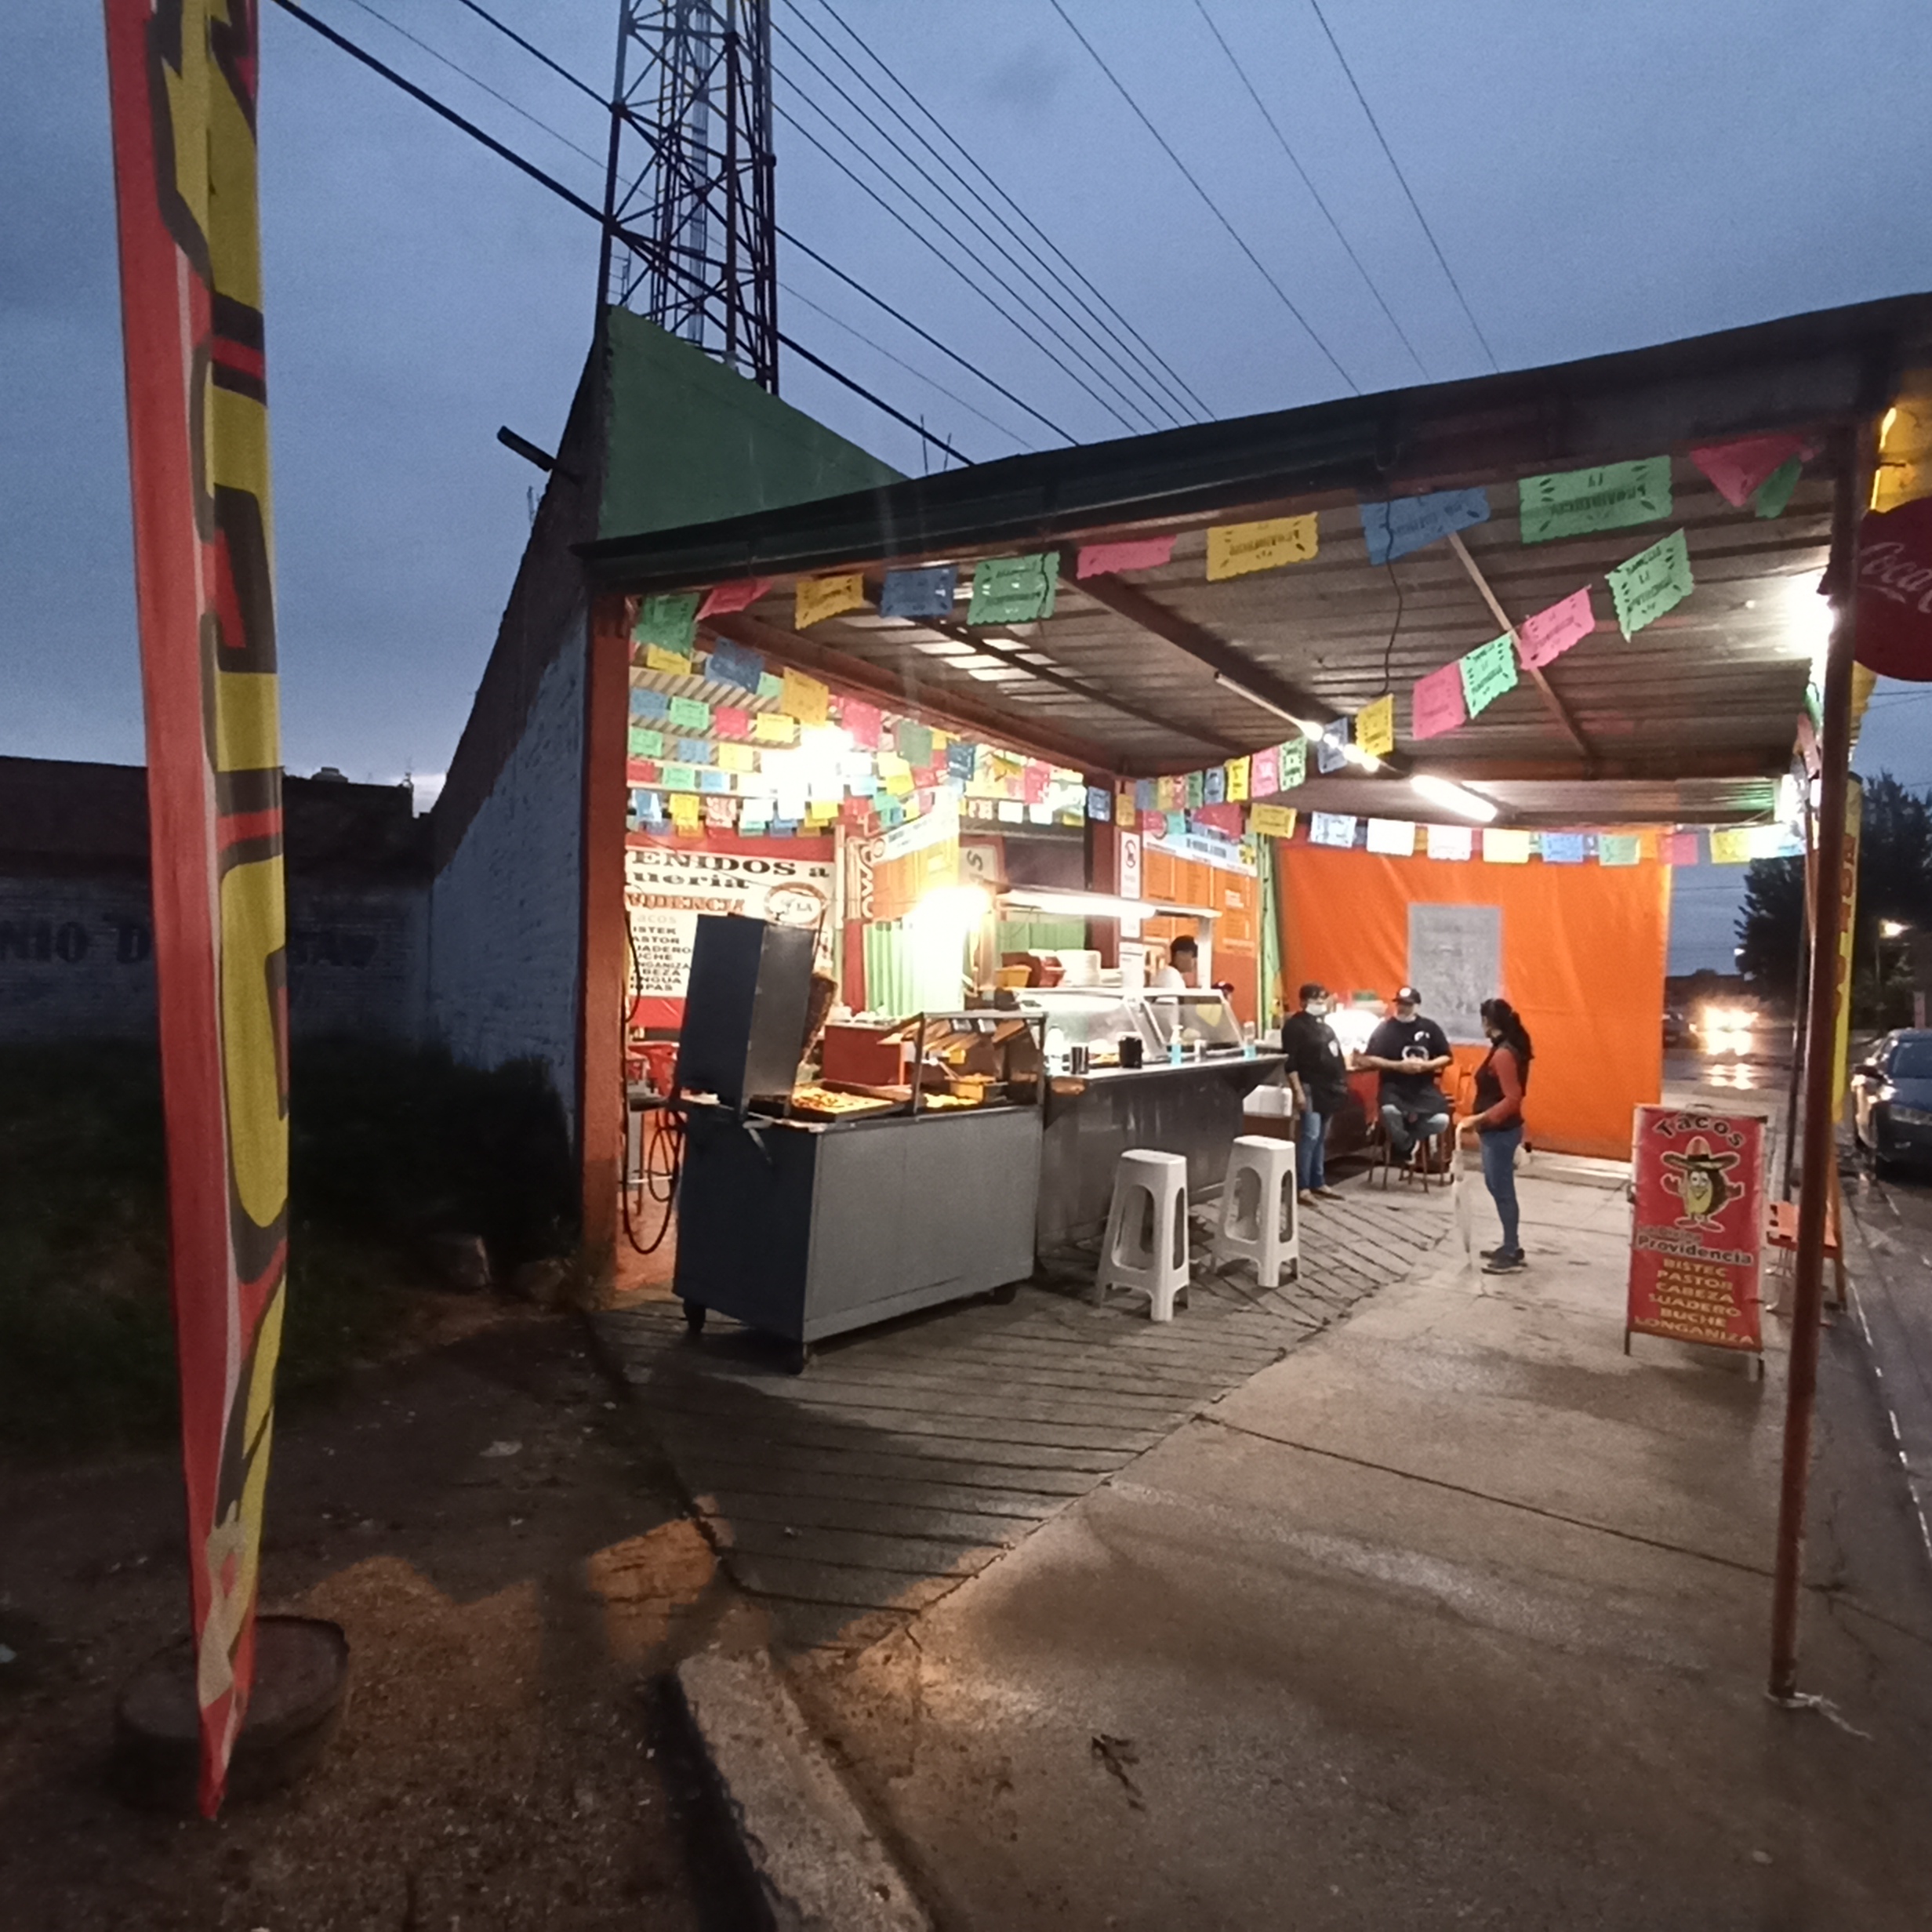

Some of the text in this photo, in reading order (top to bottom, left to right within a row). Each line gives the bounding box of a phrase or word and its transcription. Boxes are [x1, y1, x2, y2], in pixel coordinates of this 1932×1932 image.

[808, 867, 830, 878] a
[1653, 1115, 1745, 1148] Tacos
[1637, 1233, 1753, 1265] Providencia
[1663, 1258, 1728, 1277] BISTEC
[1657, 1270, 1733, 1291] PASTOR
[1655, 1282, 1734, 1304] CABEZA
[1648, 1293, 1741, 1318] SUADERO
[1660, 1307, 1726, 1327] BUCHE
[1634, 1315, 1754, 1345] LONGANIZA
